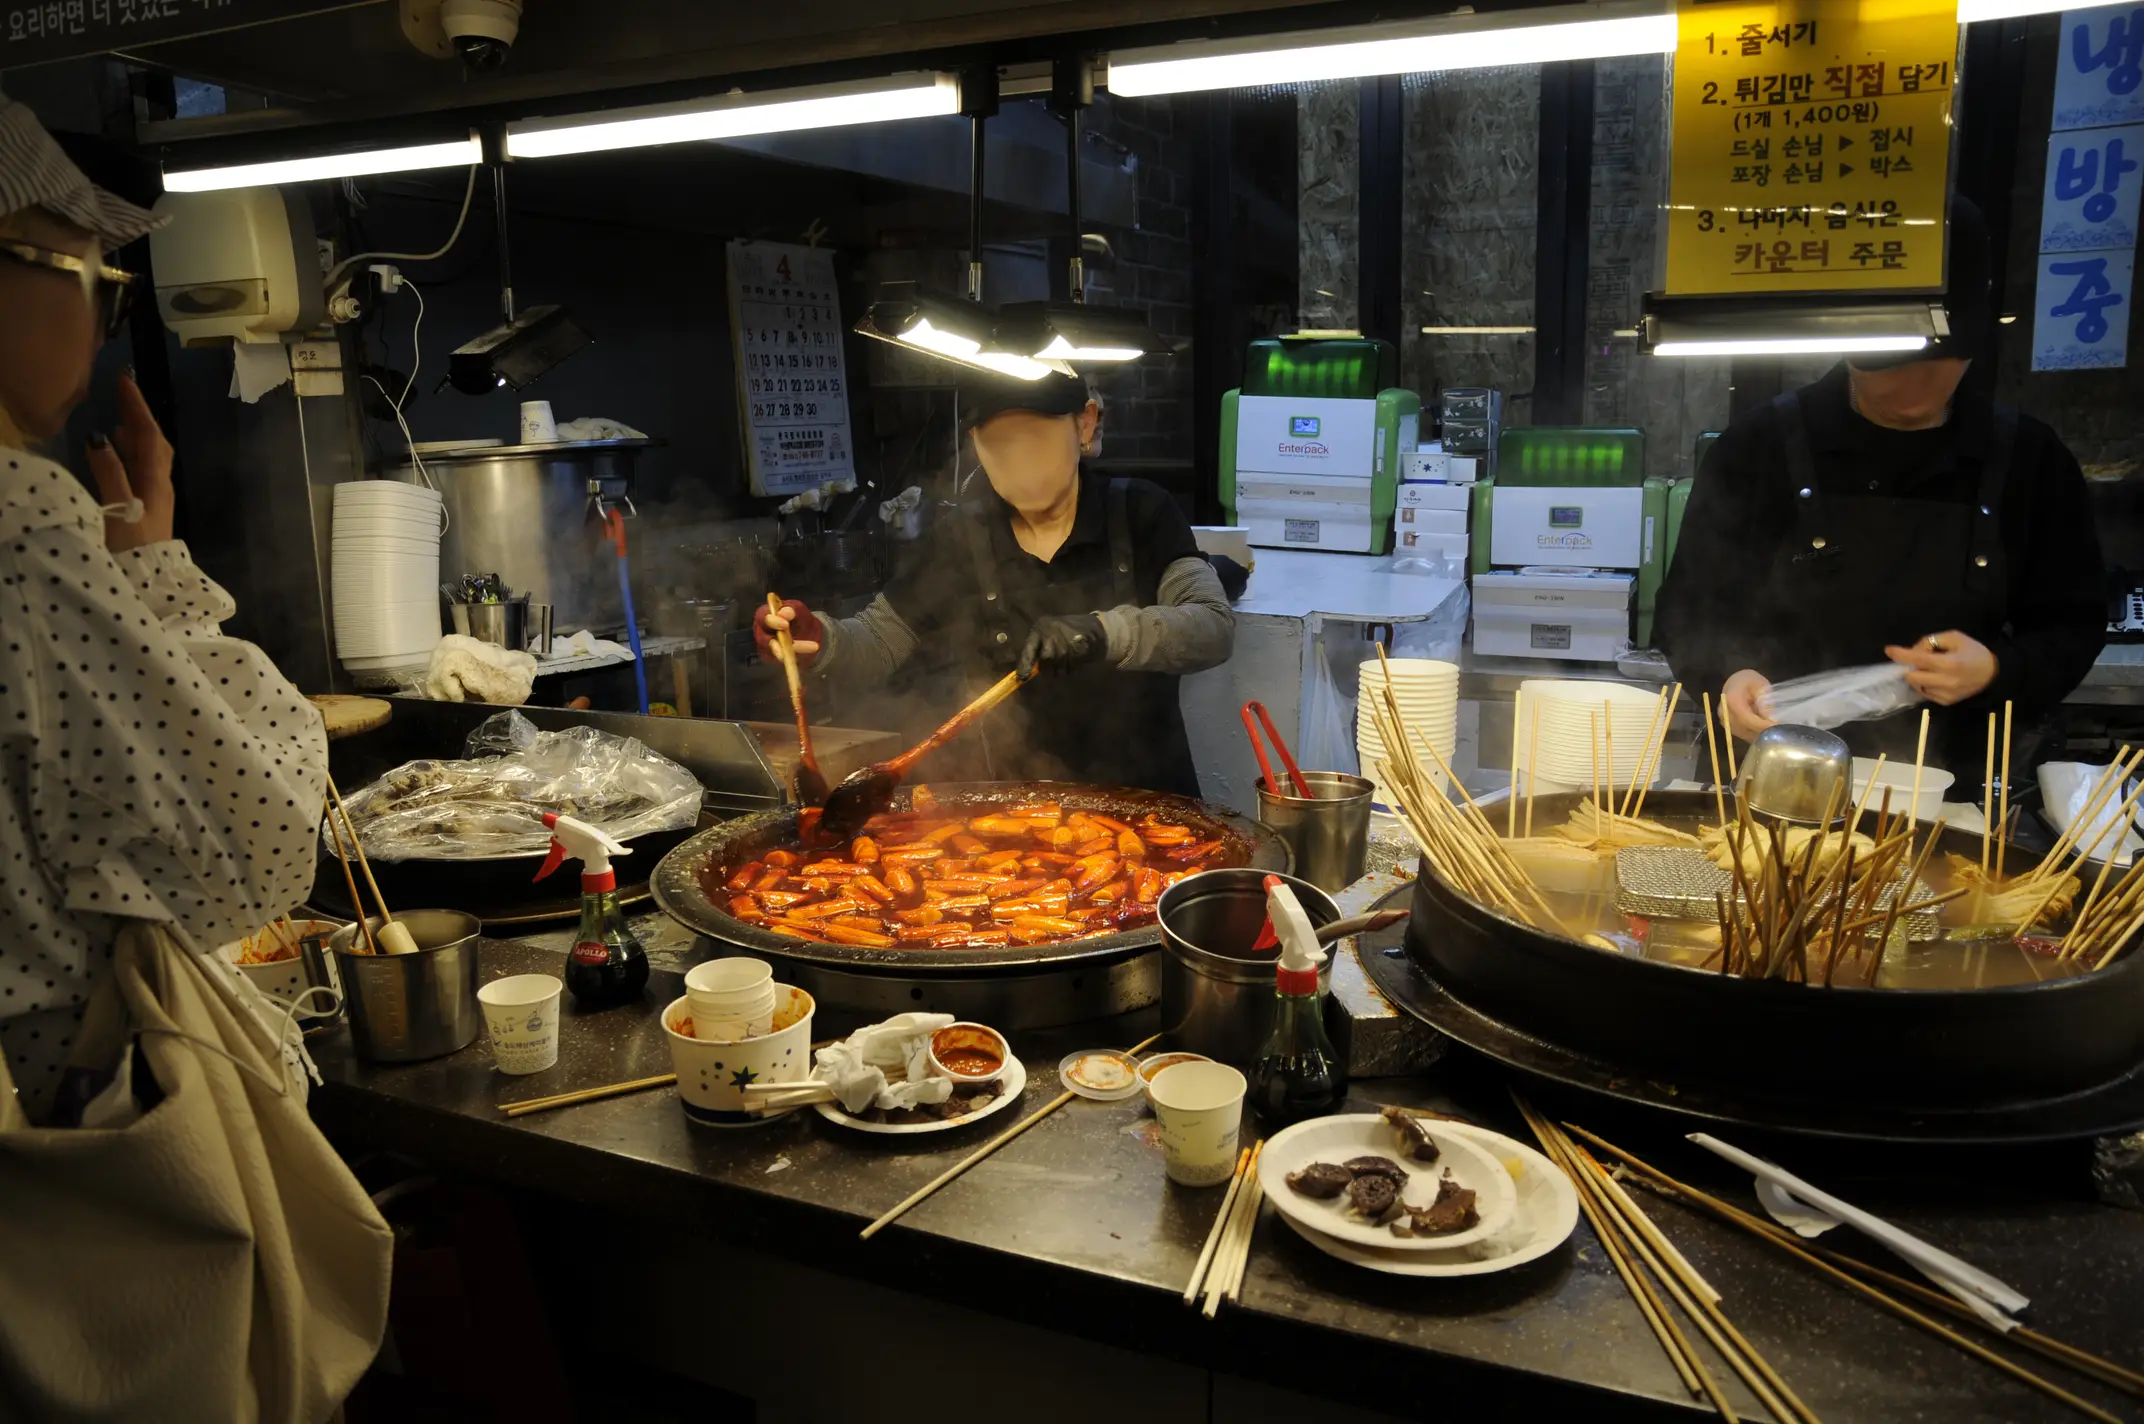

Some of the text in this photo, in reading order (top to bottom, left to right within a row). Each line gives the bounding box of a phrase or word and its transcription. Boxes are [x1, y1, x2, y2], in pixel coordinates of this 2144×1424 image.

[8, 0, 86, 42] 요리하면
[92, 0, 111, 25] 더
[1704, 21, 1817, 57] 1. 줄서기
[1701, 61, 1949, 106] 2. 튀김만 직접 담기
[1734, 101, 1880, 132] (1개 1,400원)
[1730, 126, 1914, 160] 드실 손님 접시
[1731, 155, 1914, 187] 포장 손님 박스
[1698, 200, 1903, 233] 3. 나머지 음식은
[776, 253, 792, 281] 4
[1734, 239, 1907, 274] 카운터 주문
[812, 308, 818, 321] 3
[761, 329, 767, 341] 6
[773, 329, 779, 342] 7
[802, 331, 808, 343] 9
[813, 331, 823, 344] 10
[826, 332, 835, 345] 11
[749, 353, 838, 369] 12 13 14 15 16 17 18
[751, 378, 840, 392] 19 20 21 22 23 24 25
[754, 403, 817, 417] 26 27 28 29 30
[1278, 442, 1330, 455] Enterpack
[1537, 534, 1593, 547] Enterpack
[575, 948, 608, 958] APOLLO
